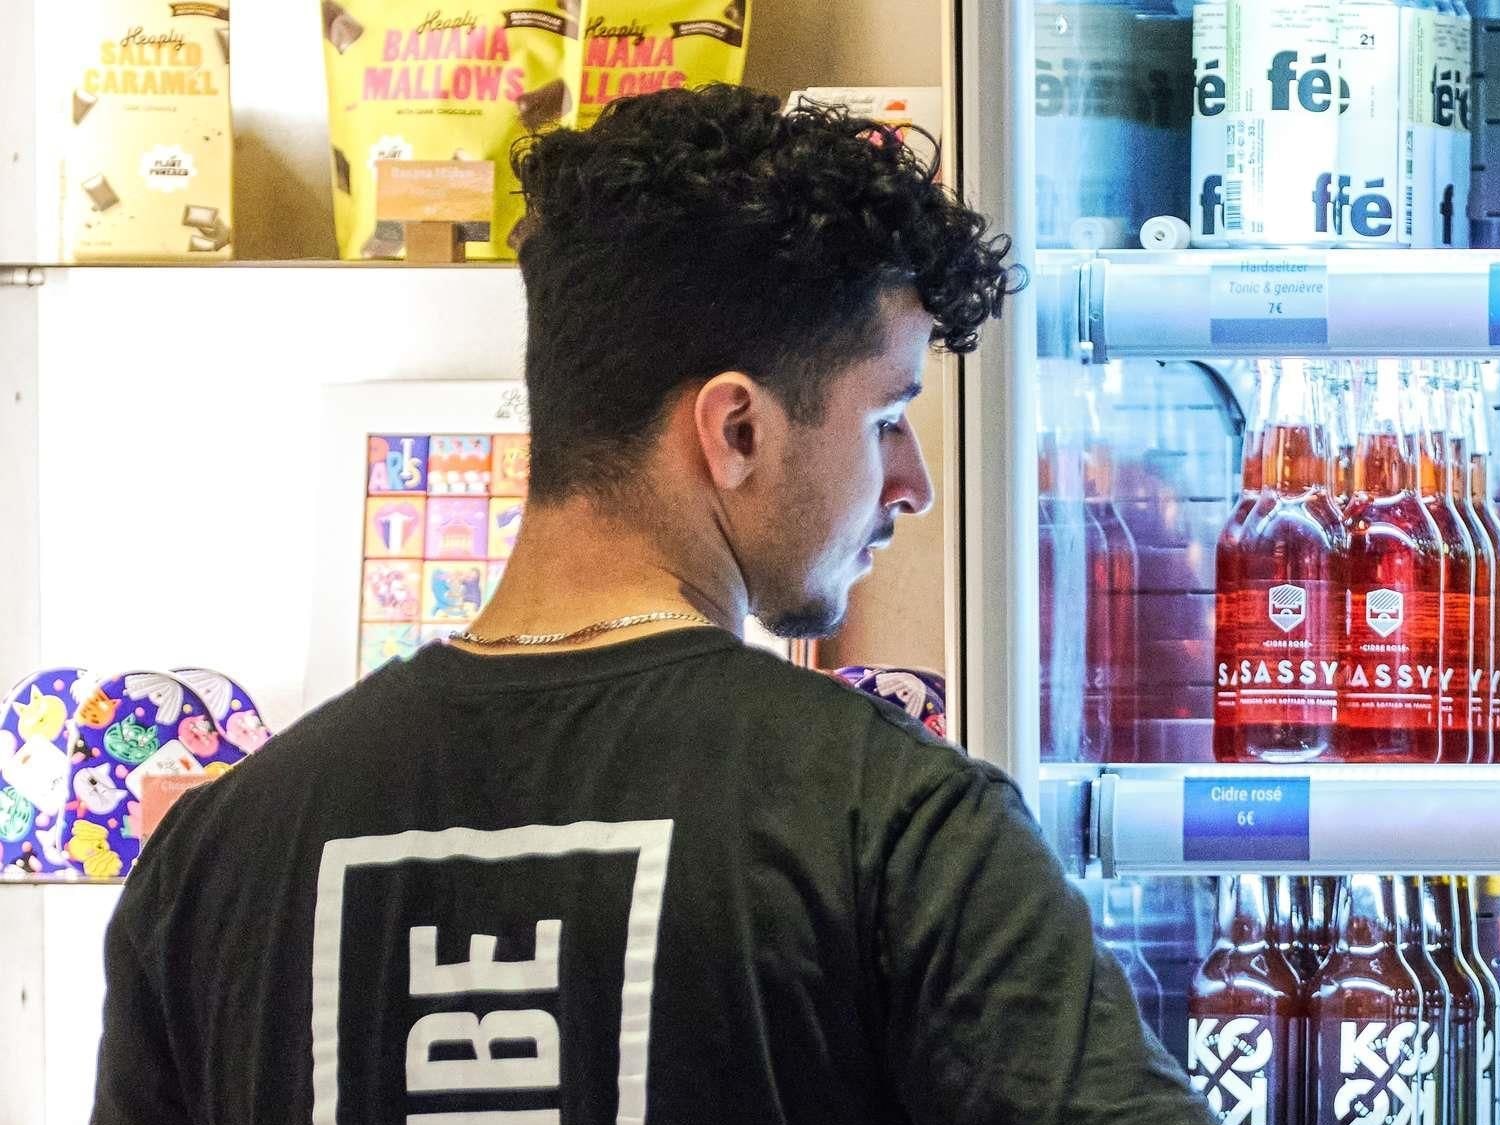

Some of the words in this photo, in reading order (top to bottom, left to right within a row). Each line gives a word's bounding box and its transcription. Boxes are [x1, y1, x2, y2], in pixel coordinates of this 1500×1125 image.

[381, 26, 510, 61] BANANA
[1360, 34, 1376, 46] 21
[100, 41, 203, 66] SALTED
[84, 68, 219, 95] CARAMEL
[363, 65, 525, 100] MALLOWS
[1267, 50, 1333, 113] fé
[1228, 282, 1260, 295] Tonic
[1263, 282, 1271, 295] &
[1274, 281, 1324, 298] genièvre
[1268, 303, 1283, 314] 7€
[1240, 659, 1338, 685] SASSY
[1211, 786, 1248, 801] Cidre
[1252, 786, 1283, 801] rosé
[1237, 810, 1255, 826] 6€
